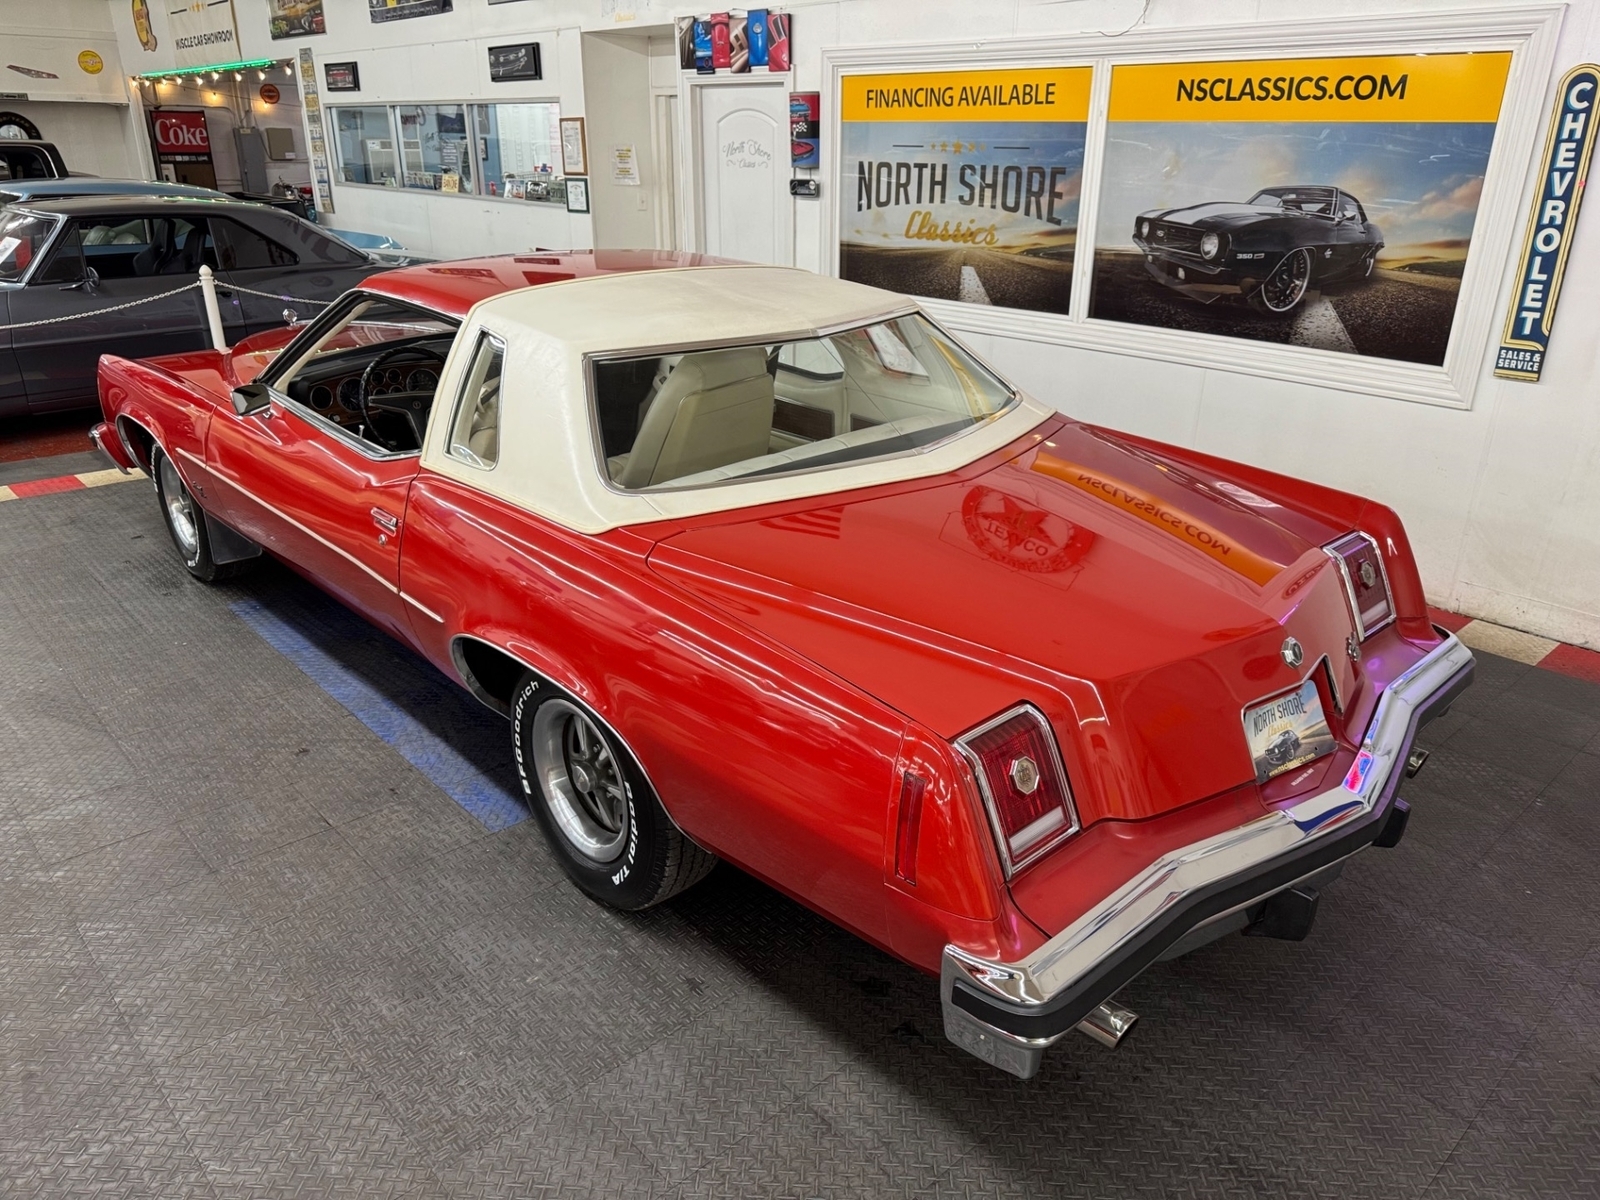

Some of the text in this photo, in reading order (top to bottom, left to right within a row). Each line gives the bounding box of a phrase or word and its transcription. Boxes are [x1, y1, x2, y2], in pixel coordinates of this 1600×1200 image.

[174, 29, 234, 50] MUSCLE CAR SHOWROOM
[866, 82, 1056, 109] FINANCING AVAILABLE
[1176, 73, 1409, 102] NSCLASSICS.COM
[154, 118, 208, 146] Coke
[722, 139, 772, 161] North Shore
[857, 160, 1067, 226] NORTH SHORE
[1518, 81, 1594, 336] CHEVROLET
[904, 210, 999, 246] Classics
[1497, 358, 1540, 371] SERVICE
[1499, 349, 1541, 362] SALES &
[1253, 694, 1307, 737] NORTH SHORE
[514, 679, 540, 795] BFGoodrich
[611, 780, 639, 886] Radial T/A
